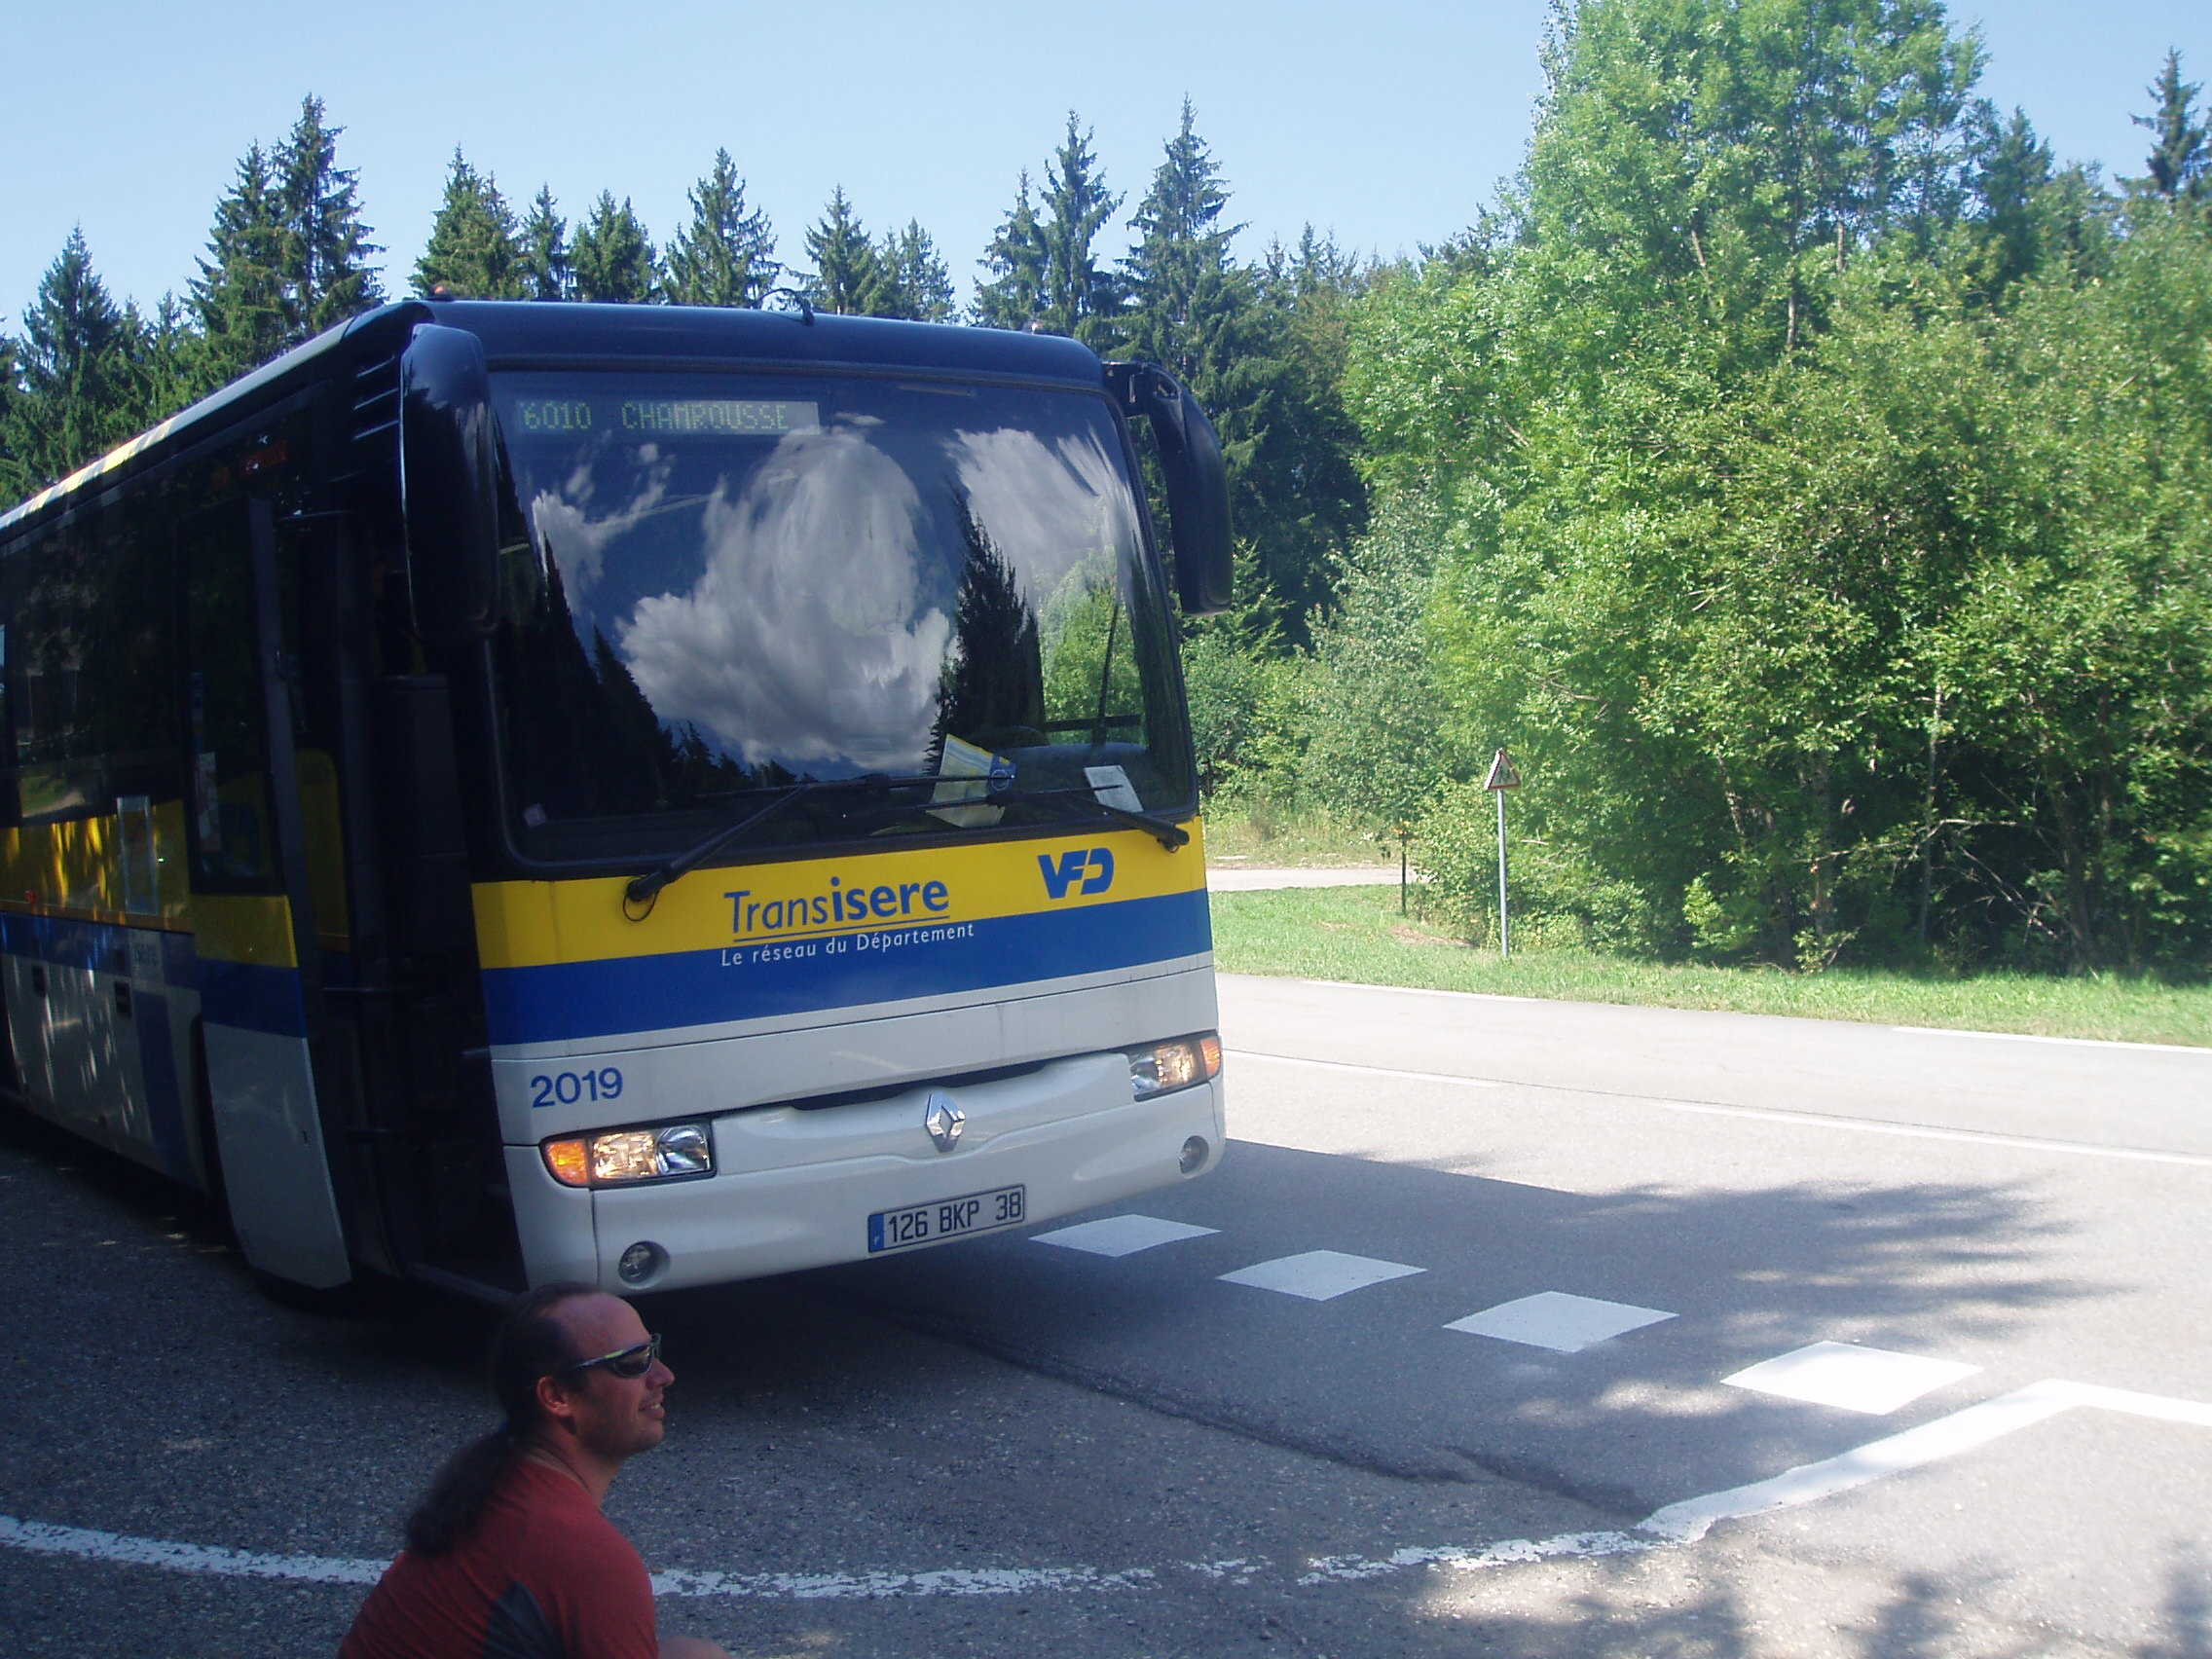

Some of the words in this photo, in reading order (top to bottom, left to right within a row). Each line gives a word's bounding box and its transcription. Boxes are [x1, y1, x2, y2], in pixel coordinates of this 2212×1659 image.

[523, 401, 592, 429] 6010
[622, 401, 789, 429] CHAMROUSSE
[1037, 846, 1115, 899] VFD
[723, 876, 949, 933] Transisere
[721, 948, 743, 967] Le
[753, 942, 817, 963] réseau
[826, 937, 847, 954] du
[857, 923, 975, 952] Département
[530, 1067, 623, 1108] 2019
[889, 1211, 928, 1242] 126
[940, 1200, 979, 1233] BKP
[995, 1192, 1021, 1221] 38
